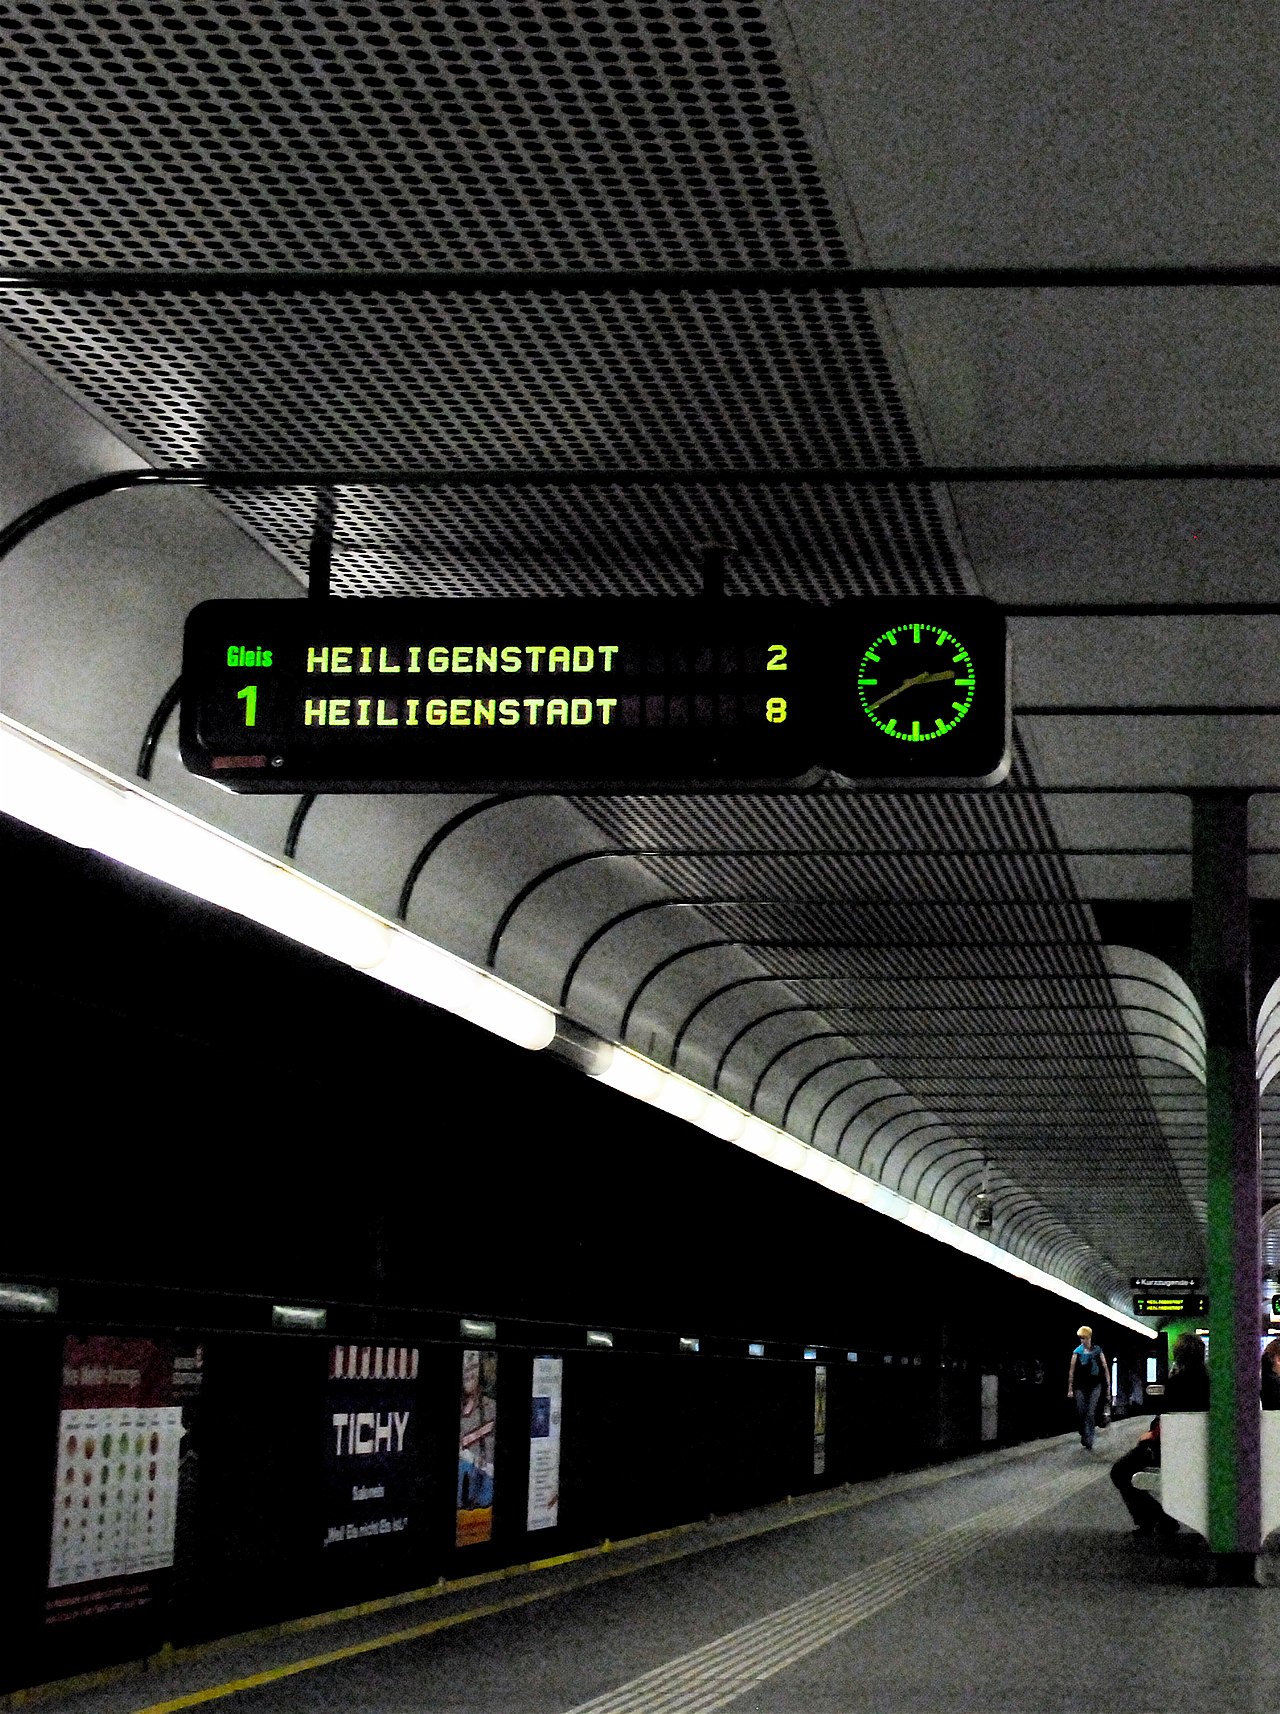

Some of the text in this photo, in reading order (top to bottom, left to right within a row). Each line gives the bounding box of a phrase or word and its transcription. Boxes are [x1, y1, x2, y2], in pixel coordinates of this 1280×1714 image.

[227, 645, 274, 669] Gleis
[306, 645, 789, 674] HEILIGENSTADT 2
[238, 686, 259, 728] 1
[305, 697, 788, 727] HEILIGENSTADT 8
[332, 1411, 410, 1456] TICHY
